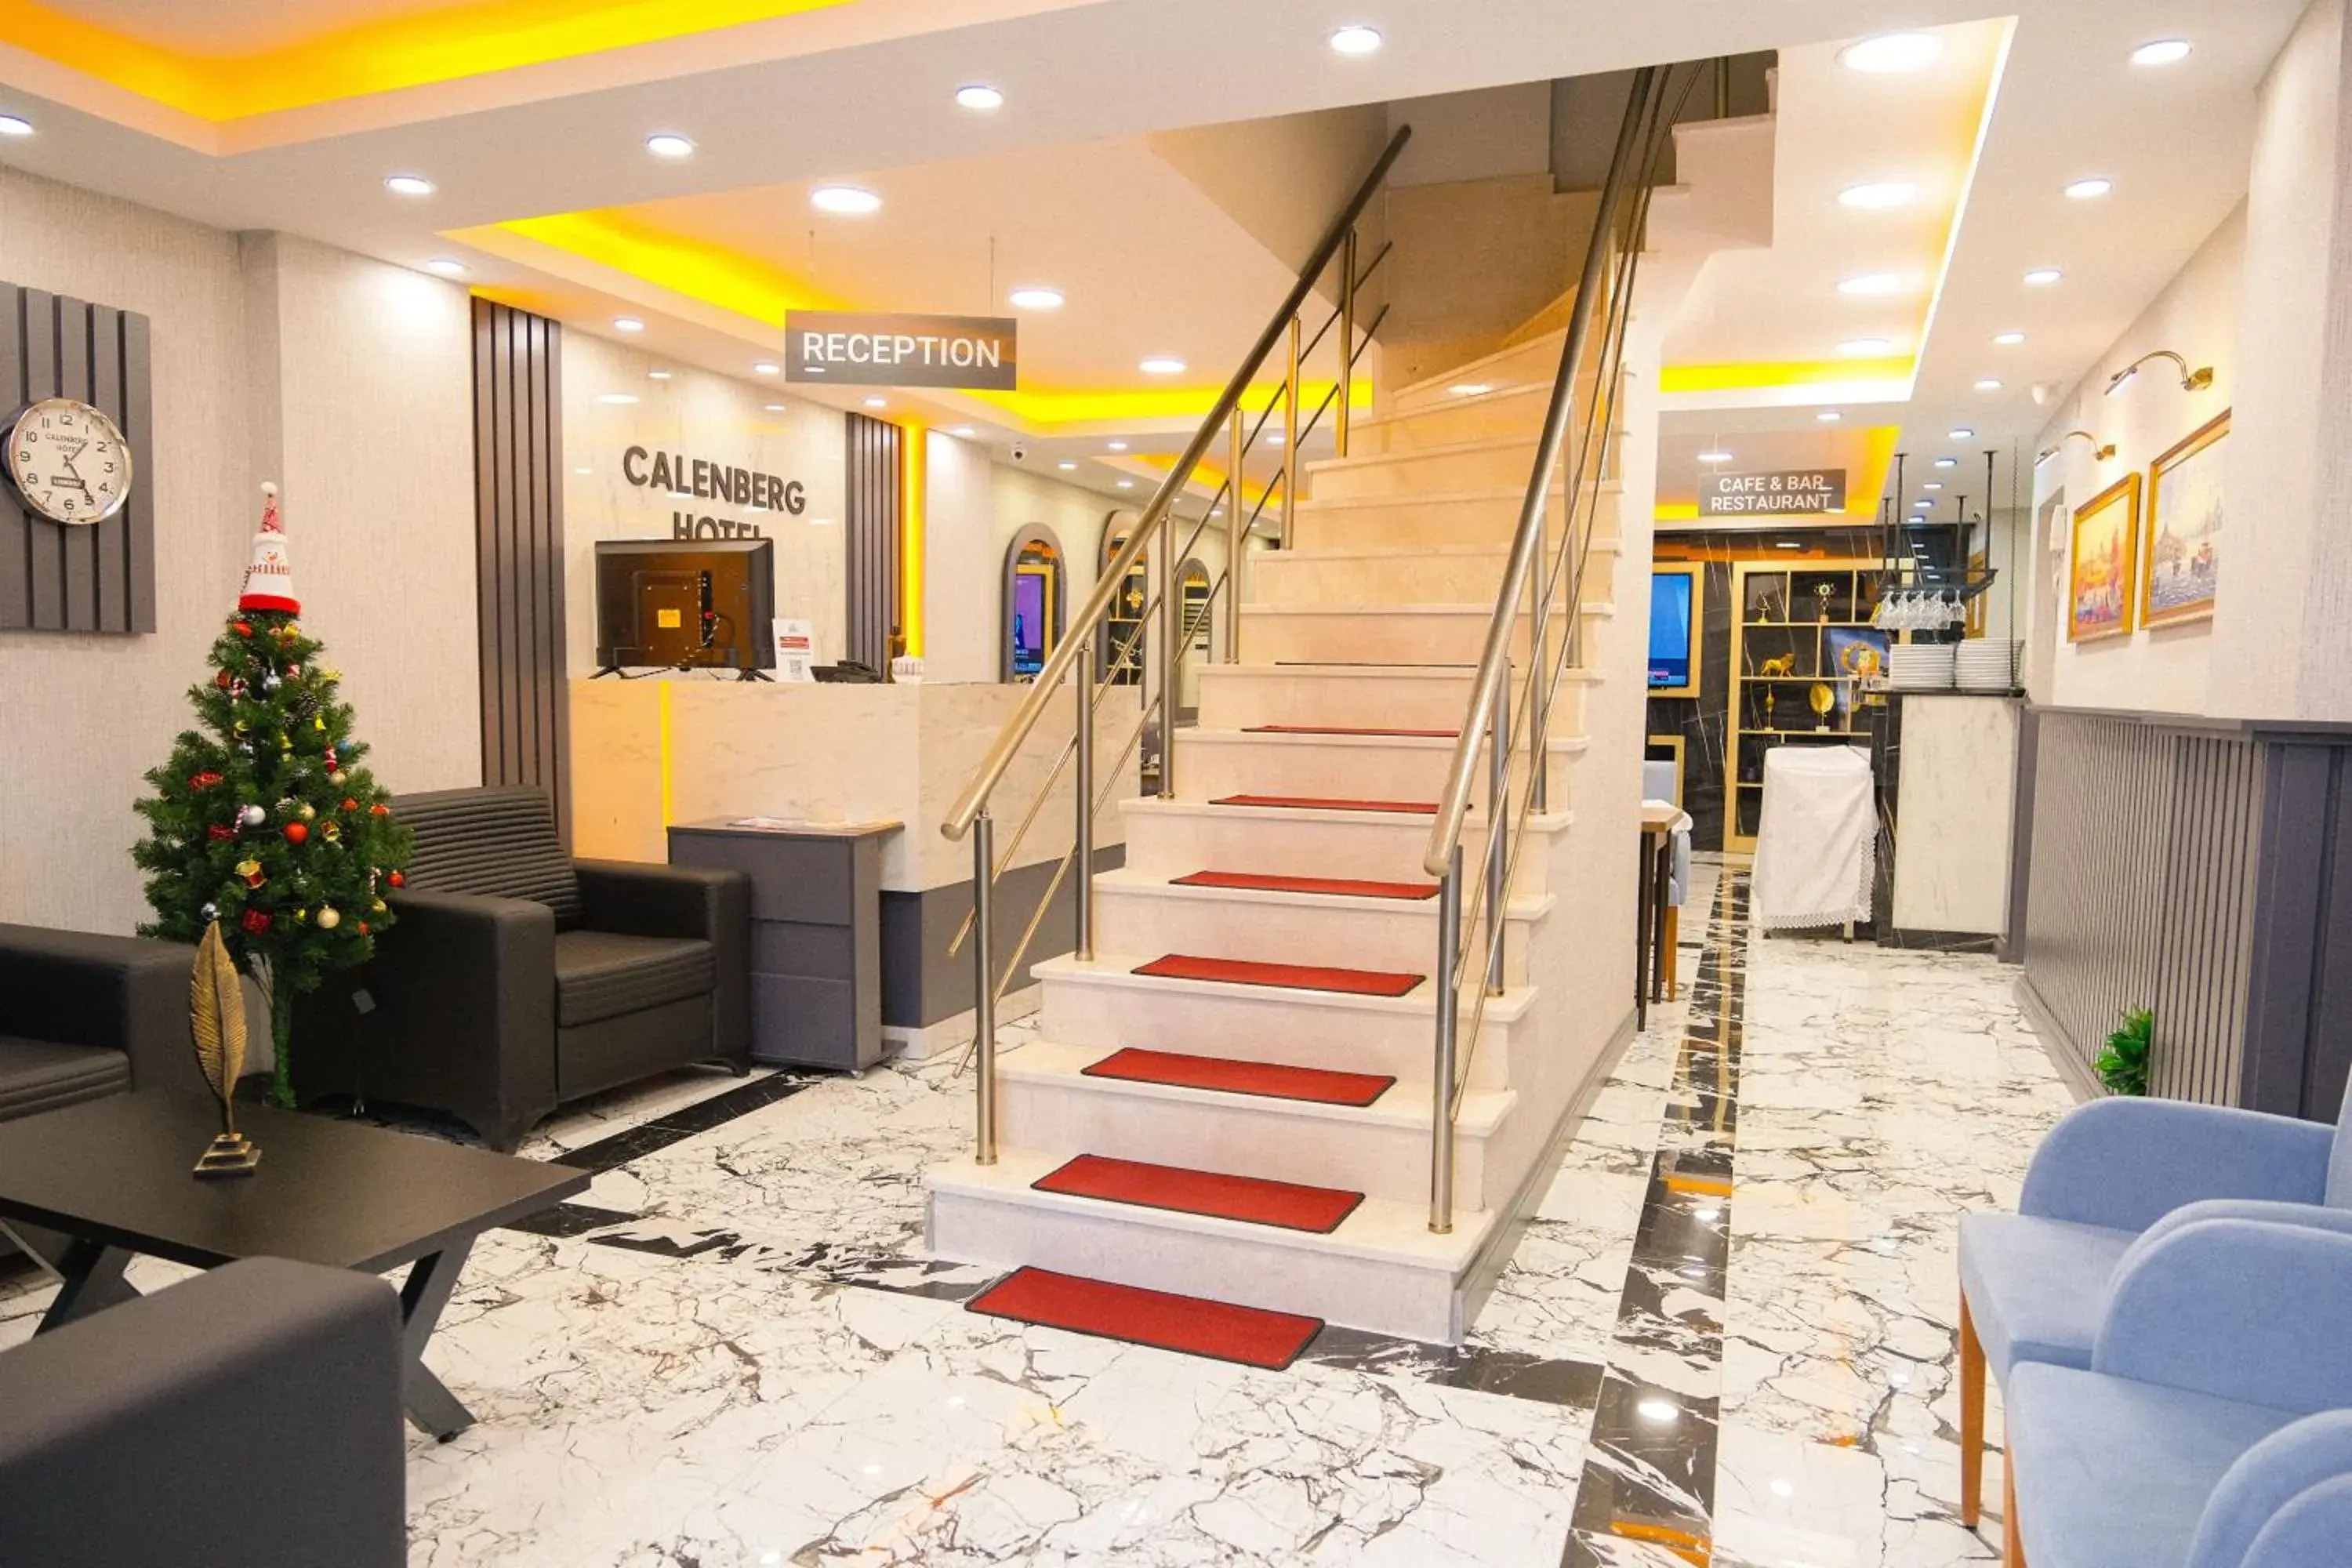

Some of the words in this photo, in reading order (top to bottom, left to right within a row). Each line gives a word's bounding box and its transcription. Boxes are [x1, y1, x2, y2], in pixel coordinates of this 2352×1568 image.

[803, 332, 1000, 368] RECEPTION
[42, 416, 50, 429] 11
[59, 414, 73, 426] 12
[26, 430, 38, 443] 10
[96, 441, 107, 452] 2
[20, 451, 31, 463] 9
[103, 461, 114, 474] 3
[26, 473, 38, 485] 8
[623, 445, 806, 515] CALENBERG
[1719, 477, 1766, 493] CAFE
[1769, 476, 1782, 491] &
[1788, 474, 1824, 490] BAR
[99, 482, 109, 492] 4
[42, 490, 53, 503] 7
[1711, 492, 1832, 512] RESTAURANT
[64, 499, 74, 510] 6
